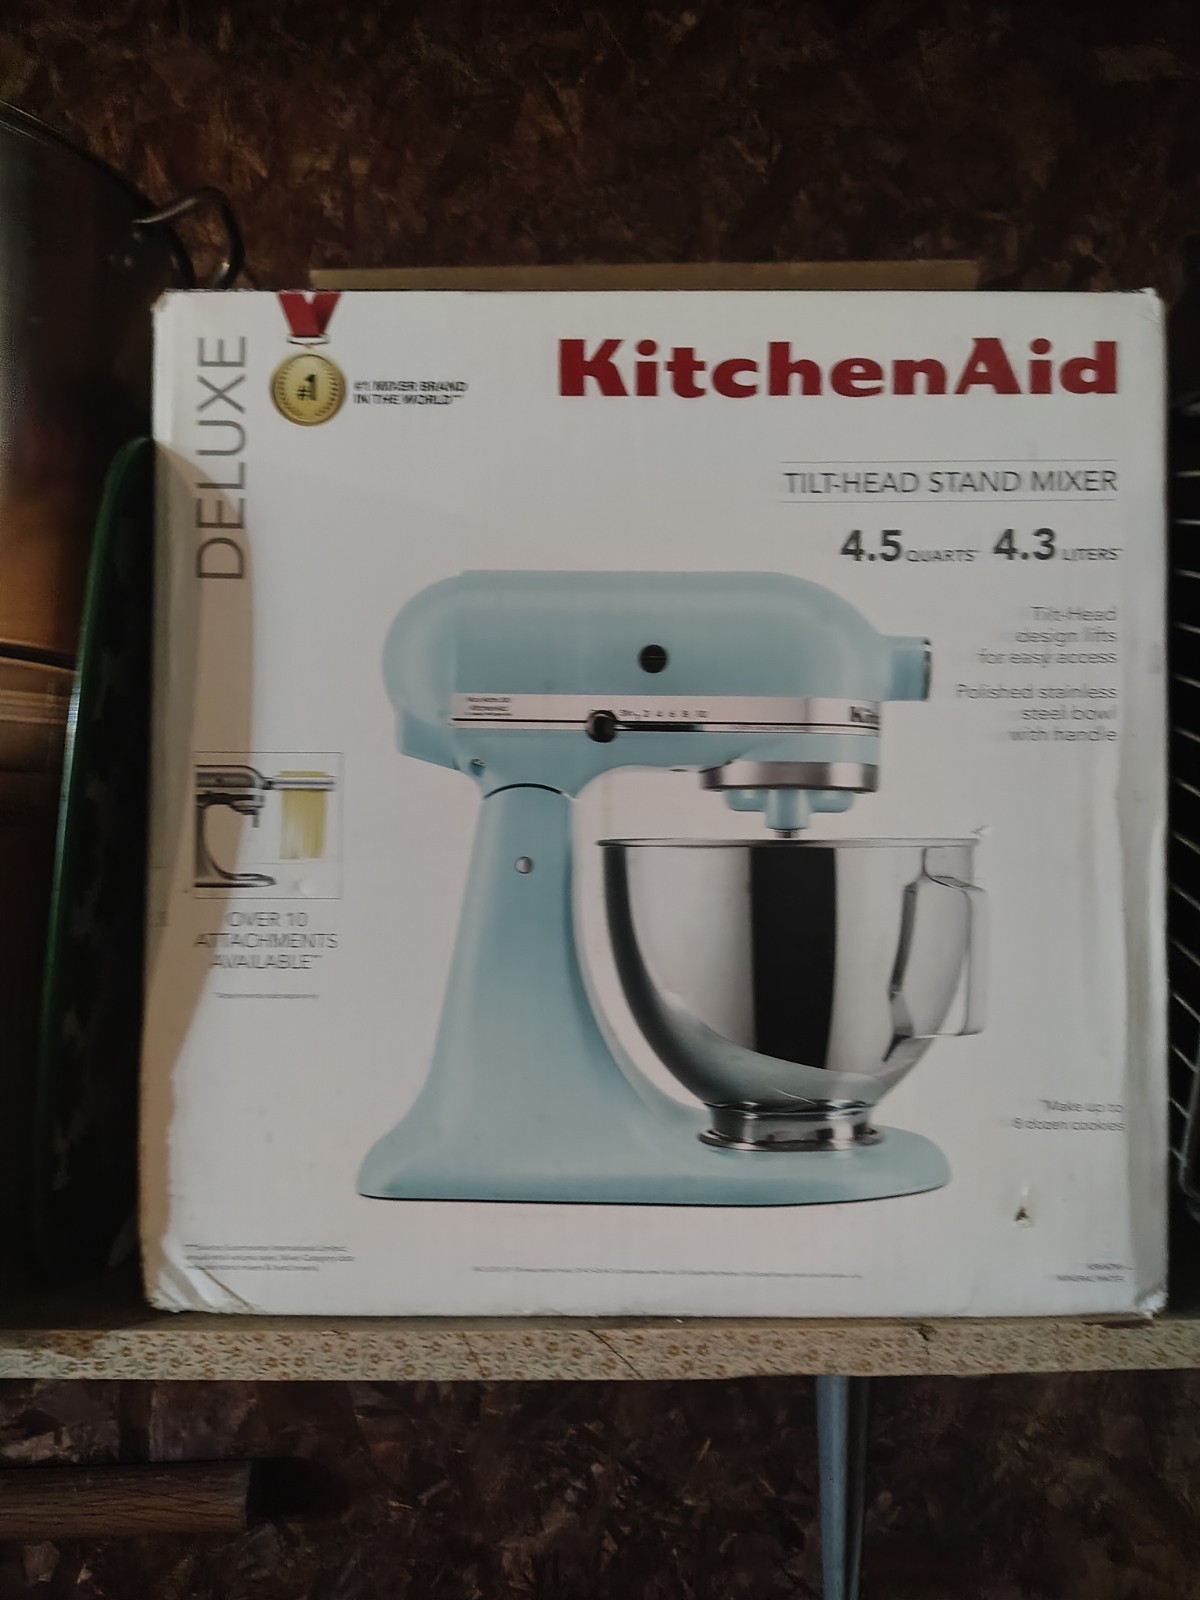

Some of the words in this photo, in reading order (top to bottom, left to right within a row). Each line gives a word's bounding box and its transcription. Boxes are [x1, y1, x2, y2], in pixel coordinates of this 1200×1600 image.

[558, 337, 1118, 397] KitchenAid
[297, 373, 317, 401] #1
[420, 381, 468, 391] BRAND
[354, 394, 370, 404] IN
[371, 394, 399, 405] THE
[196, 336, 247, 579] DELUXE
[784, 472, 919, 493] TILT-HEAD
[928, 471, 1022, 492] STAND
[1030, 470, 1117, 491] MIXER
[840, 530, 902, 561] 4.5
[993, 528, 1056, 560] 4.3
[1031, 606, 1117, 621] Tilt-Head
[1015, 627, 1078, 647] design
[1085, 626, 1117, 642] lifts
[977, 648, 1005, 664] for
[1010, 653, 1051, 668] easy
[1056, 653, 1117, 664] access
[956, 683, 1034, 699] Polished
[1039, 683, 1117, 698] stainless
[1022, 704, 1066, 720] steel
[1072, 704, 1117, 720] bowl
[1008, 726, 1048, 741] with
[1054, 725, 1117, 741] handle
[227, 912, 281, 926] OVER
[286, 912, 309, 926] 10
[195, 932, 339, 948] ATTACHMENTS
[1072, 1120, 1125, 1132] cookies
